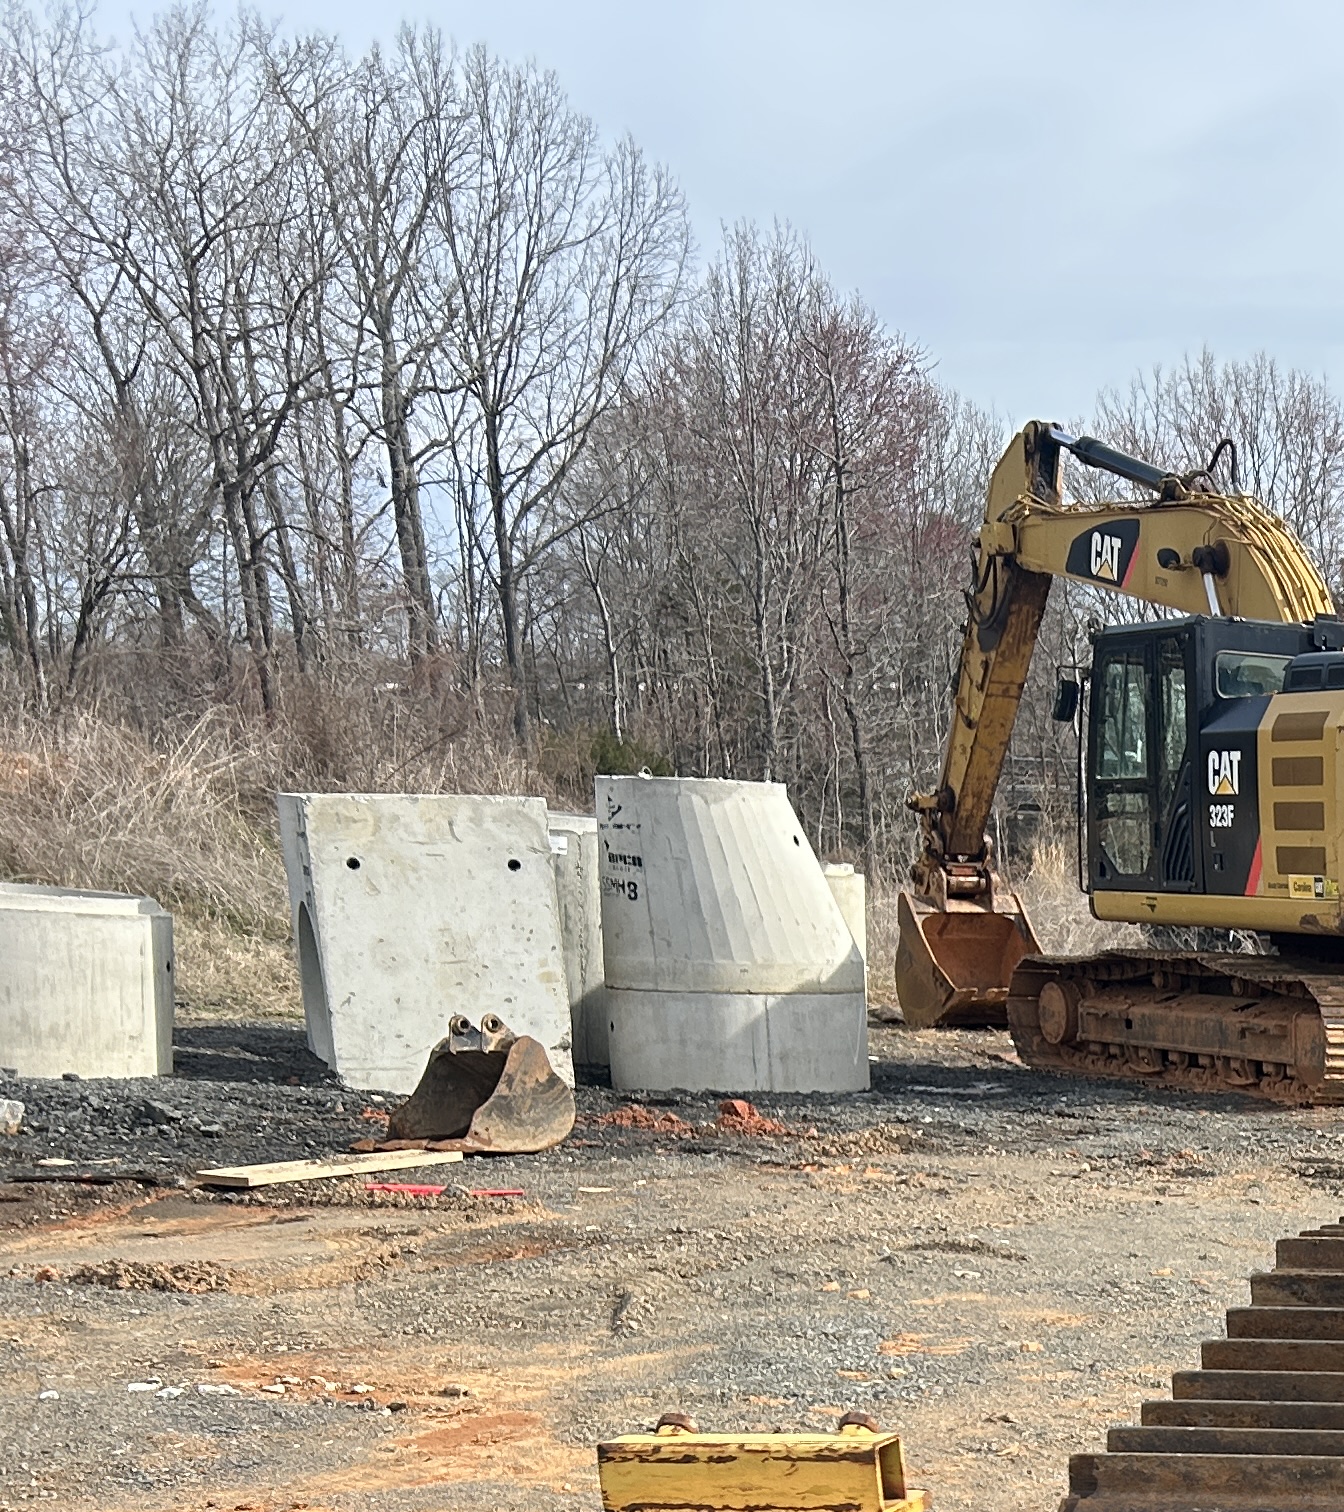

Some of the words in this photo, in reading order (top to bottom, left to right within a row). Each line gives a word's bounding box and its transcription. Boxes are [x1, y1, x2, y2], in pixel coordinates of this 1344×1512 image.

[1091, 532, 1122, 581] CAT
[1208, 750, 1241, 795] CAT
[1210, 804, 1235, 828] 323F
